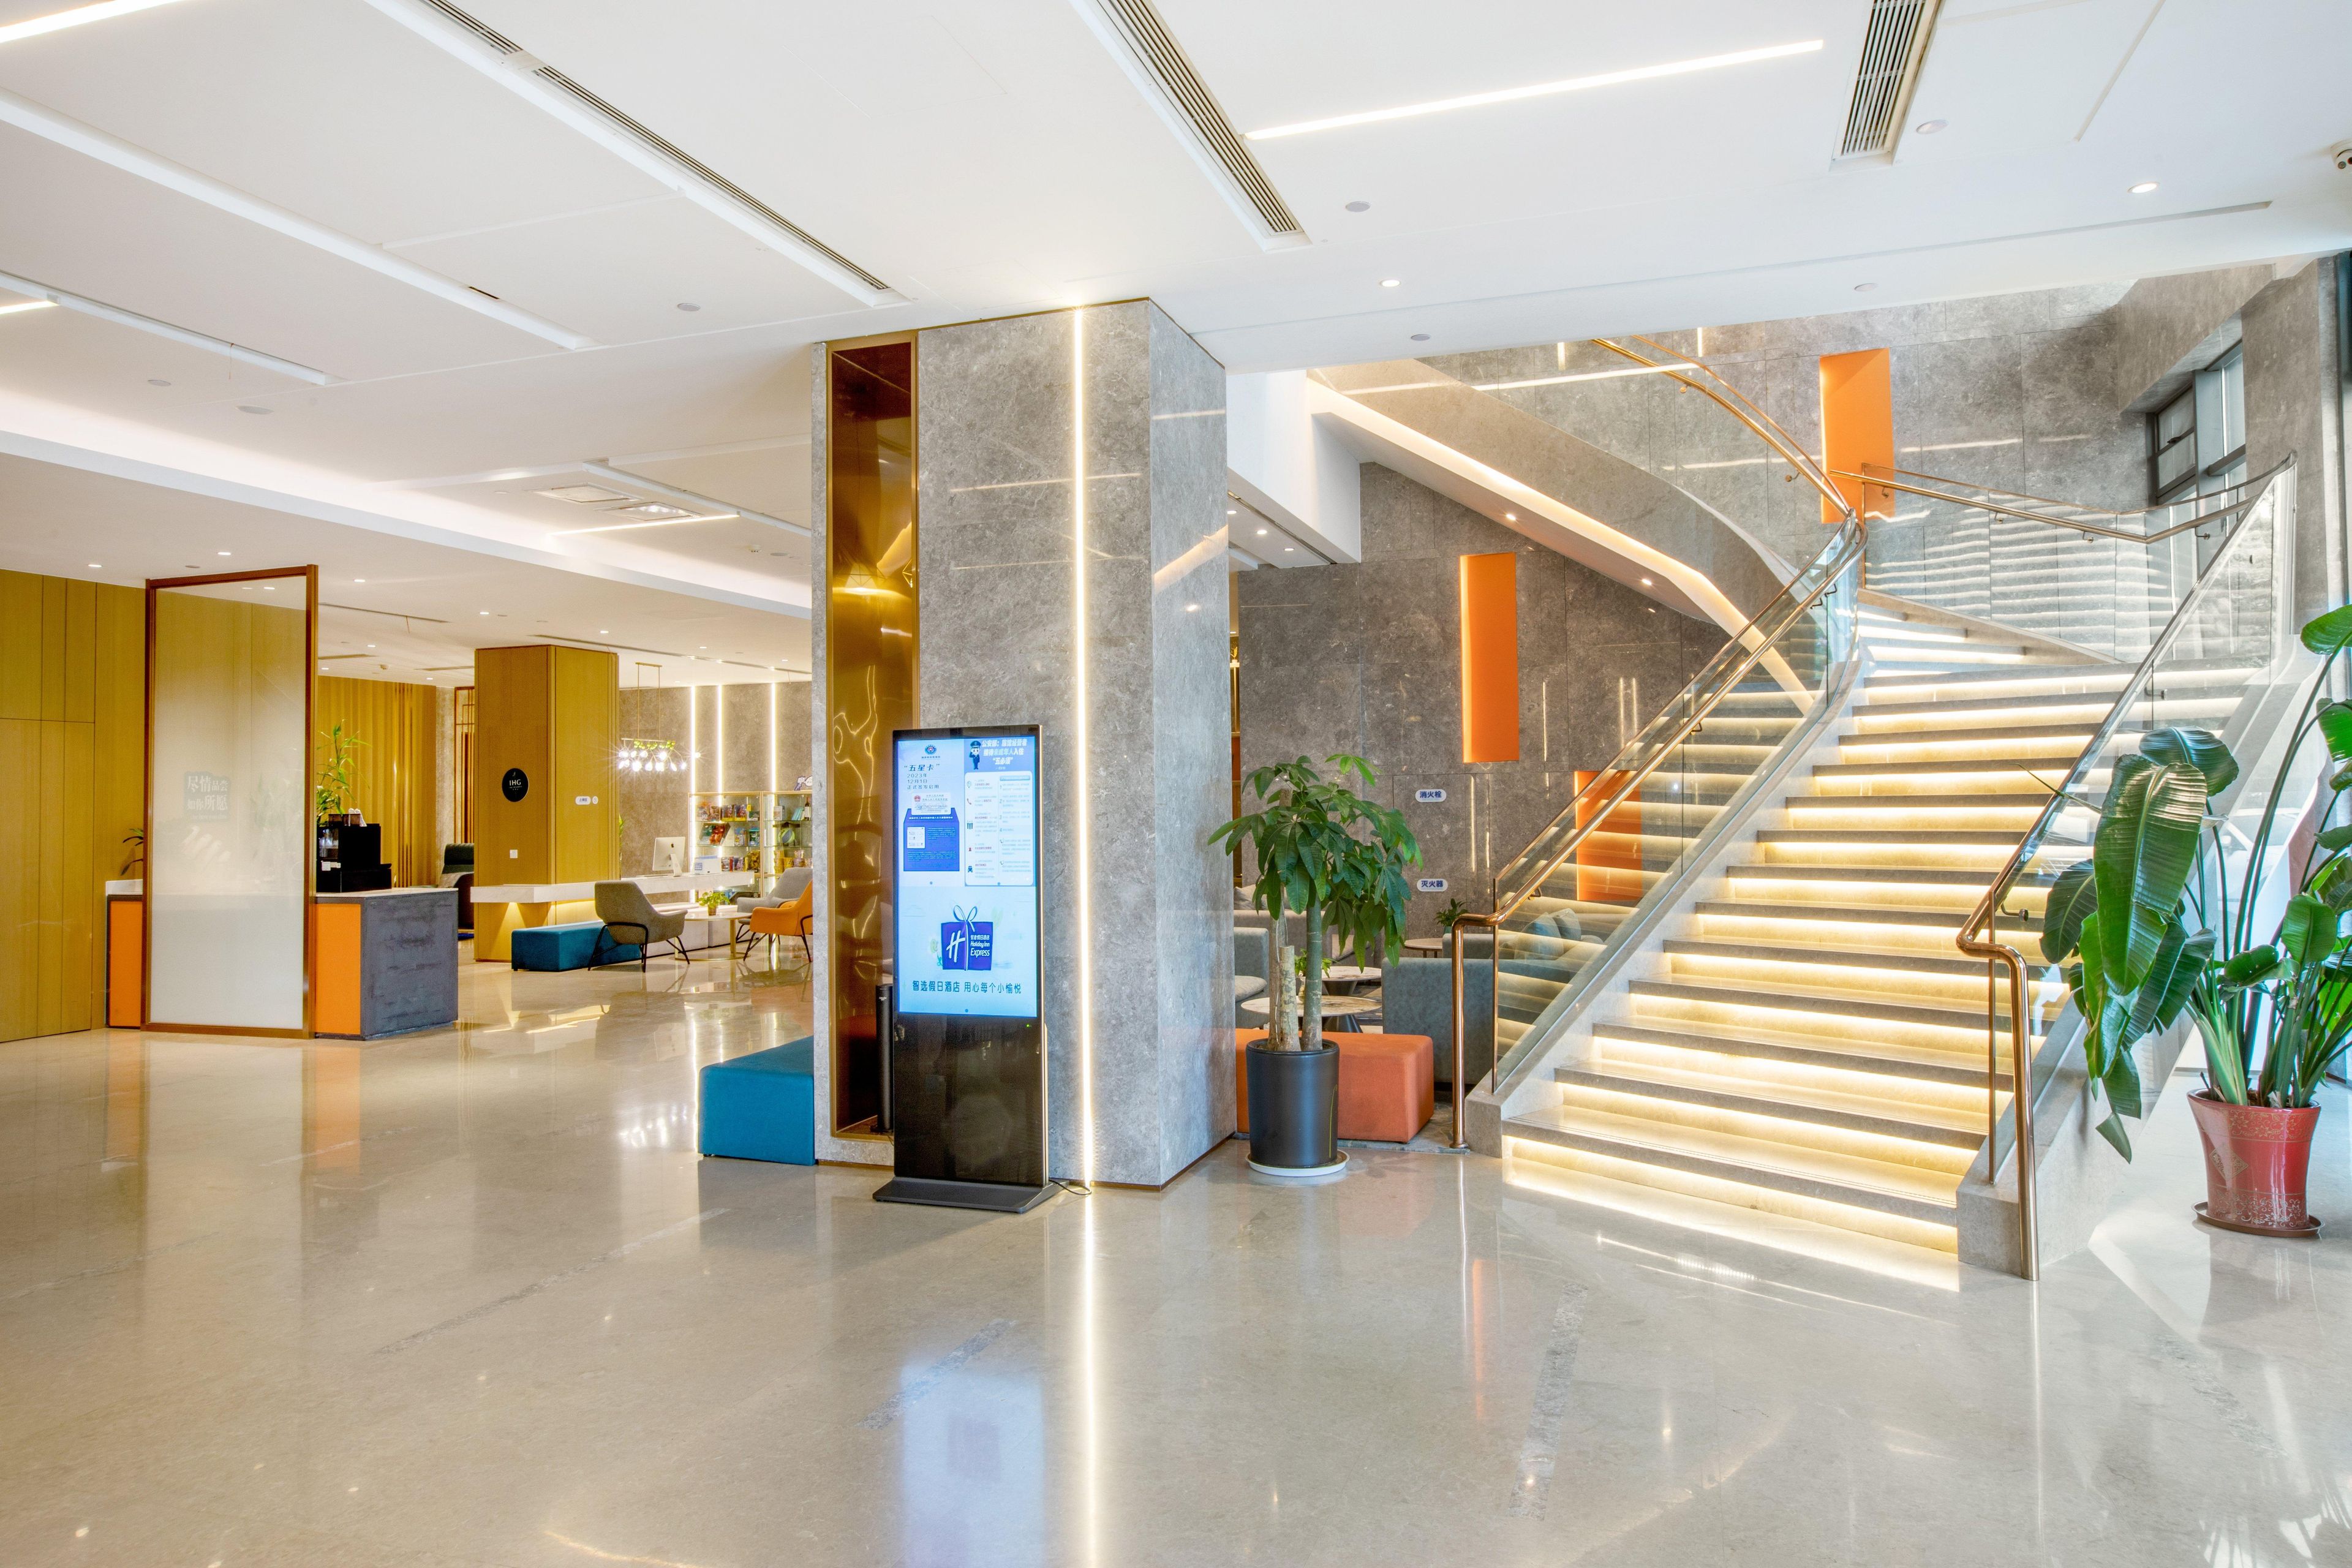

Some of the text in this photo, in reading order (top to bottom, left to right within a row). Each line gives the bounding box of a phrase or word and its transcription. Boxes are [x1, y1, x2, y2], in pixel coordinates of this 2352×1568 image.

[970, 948, 990, 958] Express
[913, 980, 1022, 994] 智选假日酒店 用心每个小愉悦
